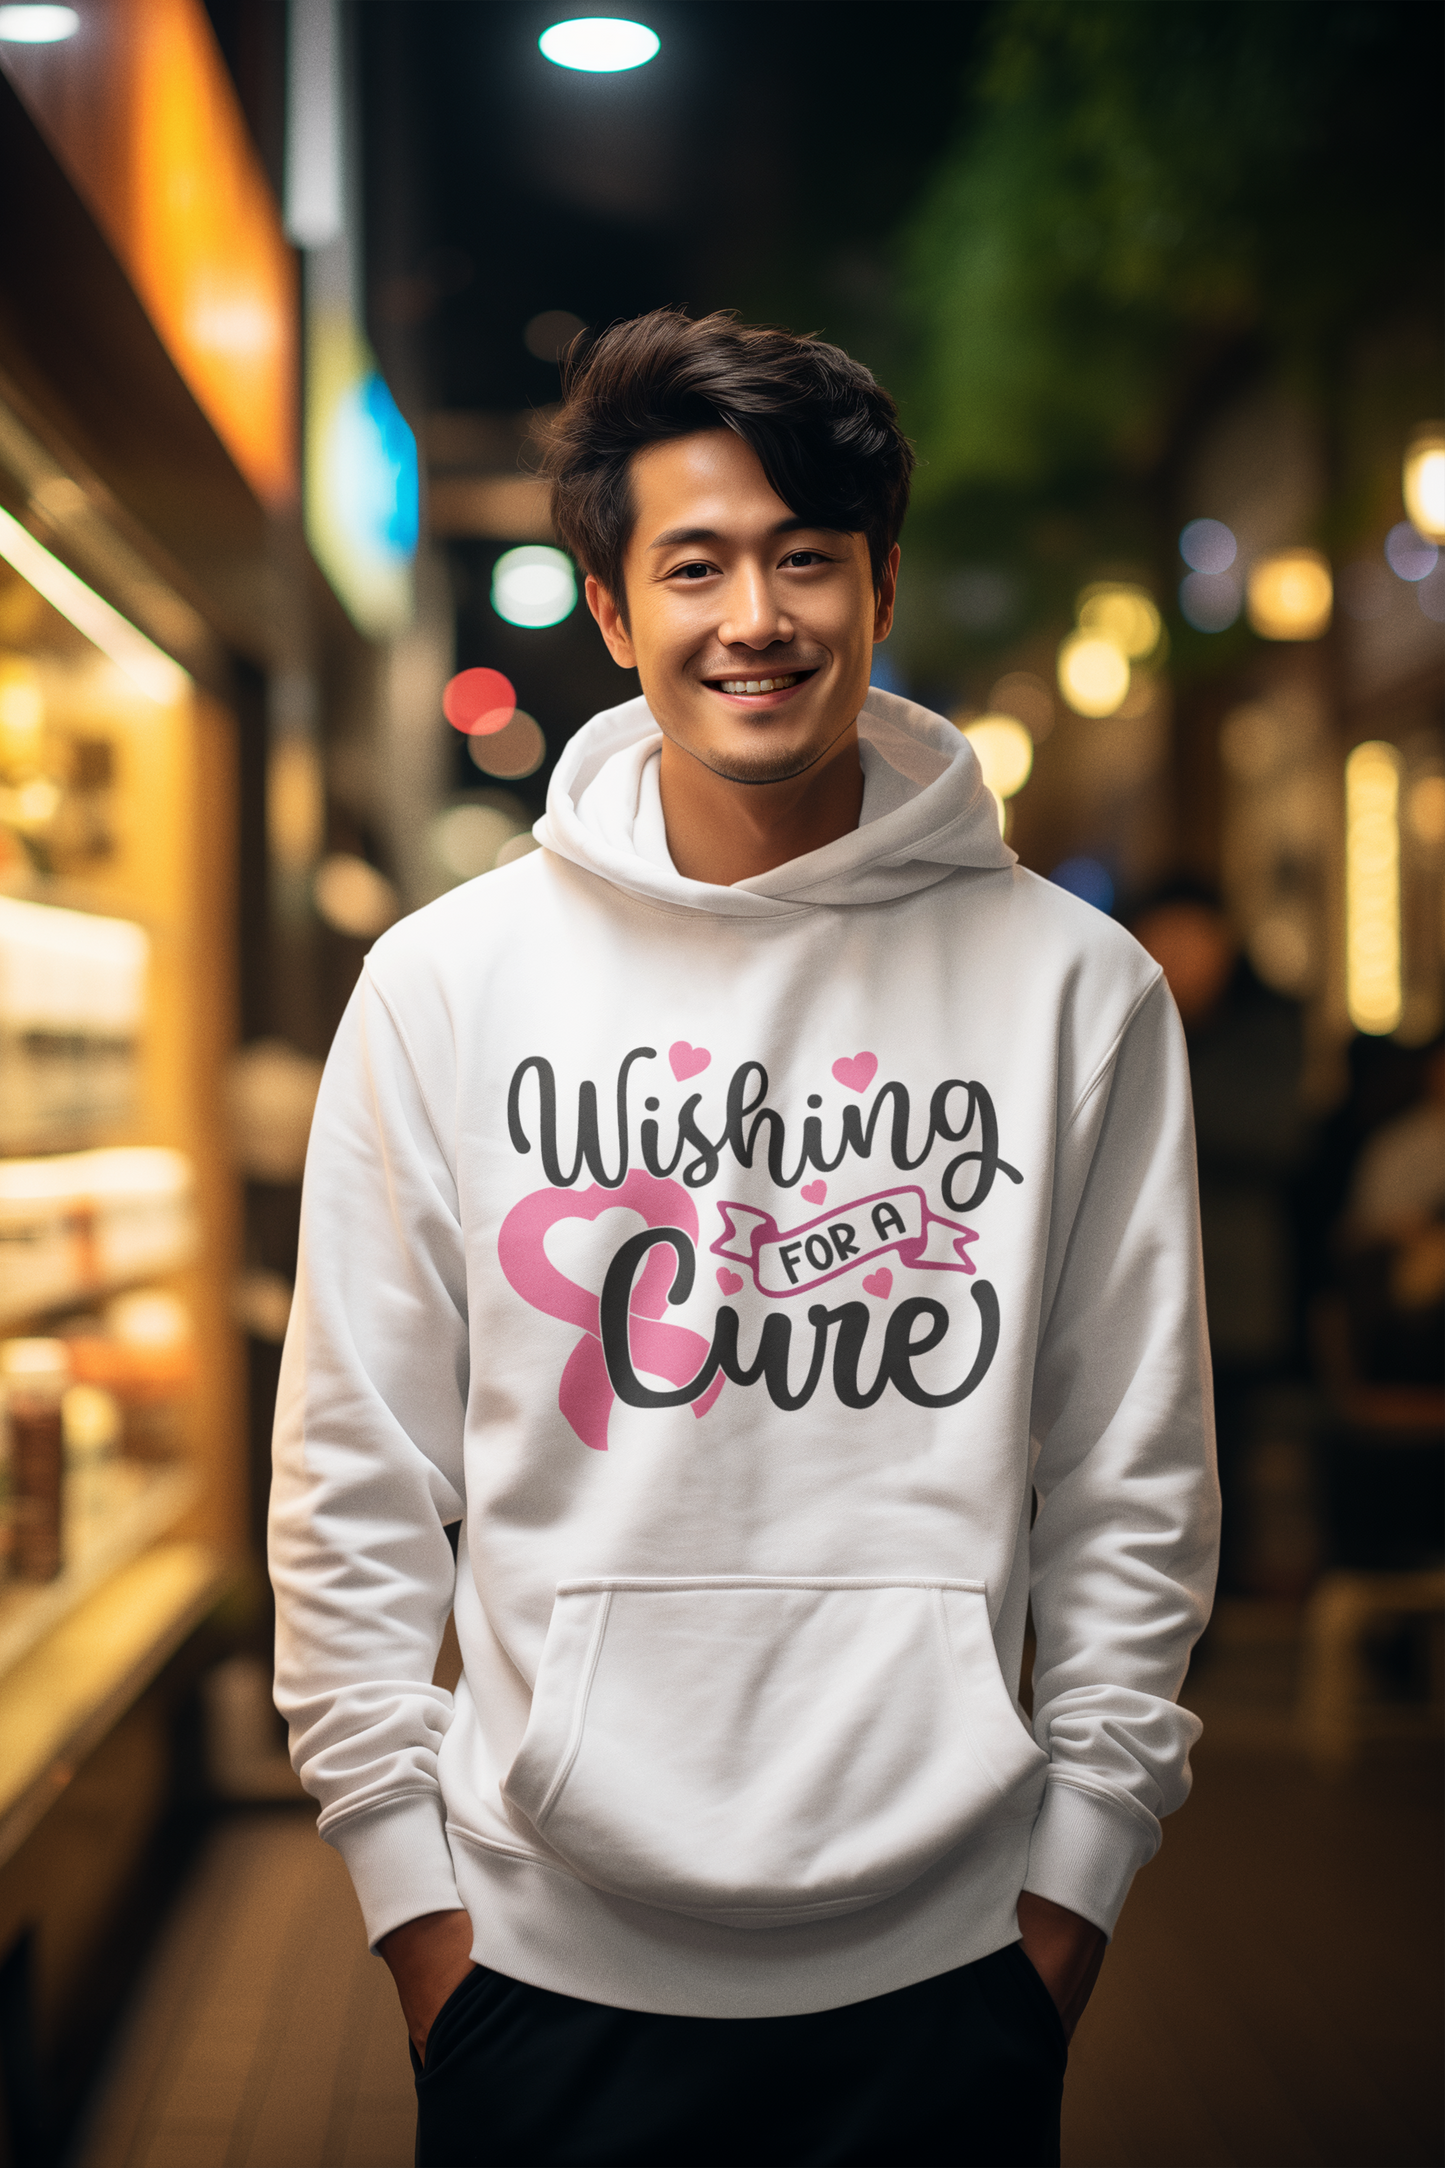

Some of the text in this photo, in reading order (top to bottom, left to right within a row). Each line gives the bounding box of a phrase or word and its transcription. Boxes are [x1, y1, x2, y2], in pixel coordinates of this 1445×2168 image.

[507, 1047, 1024, 1213] Wishing
[600, 1227, 1000, 1412] Cure
[778, 1202, 906, 1285] FOR A
